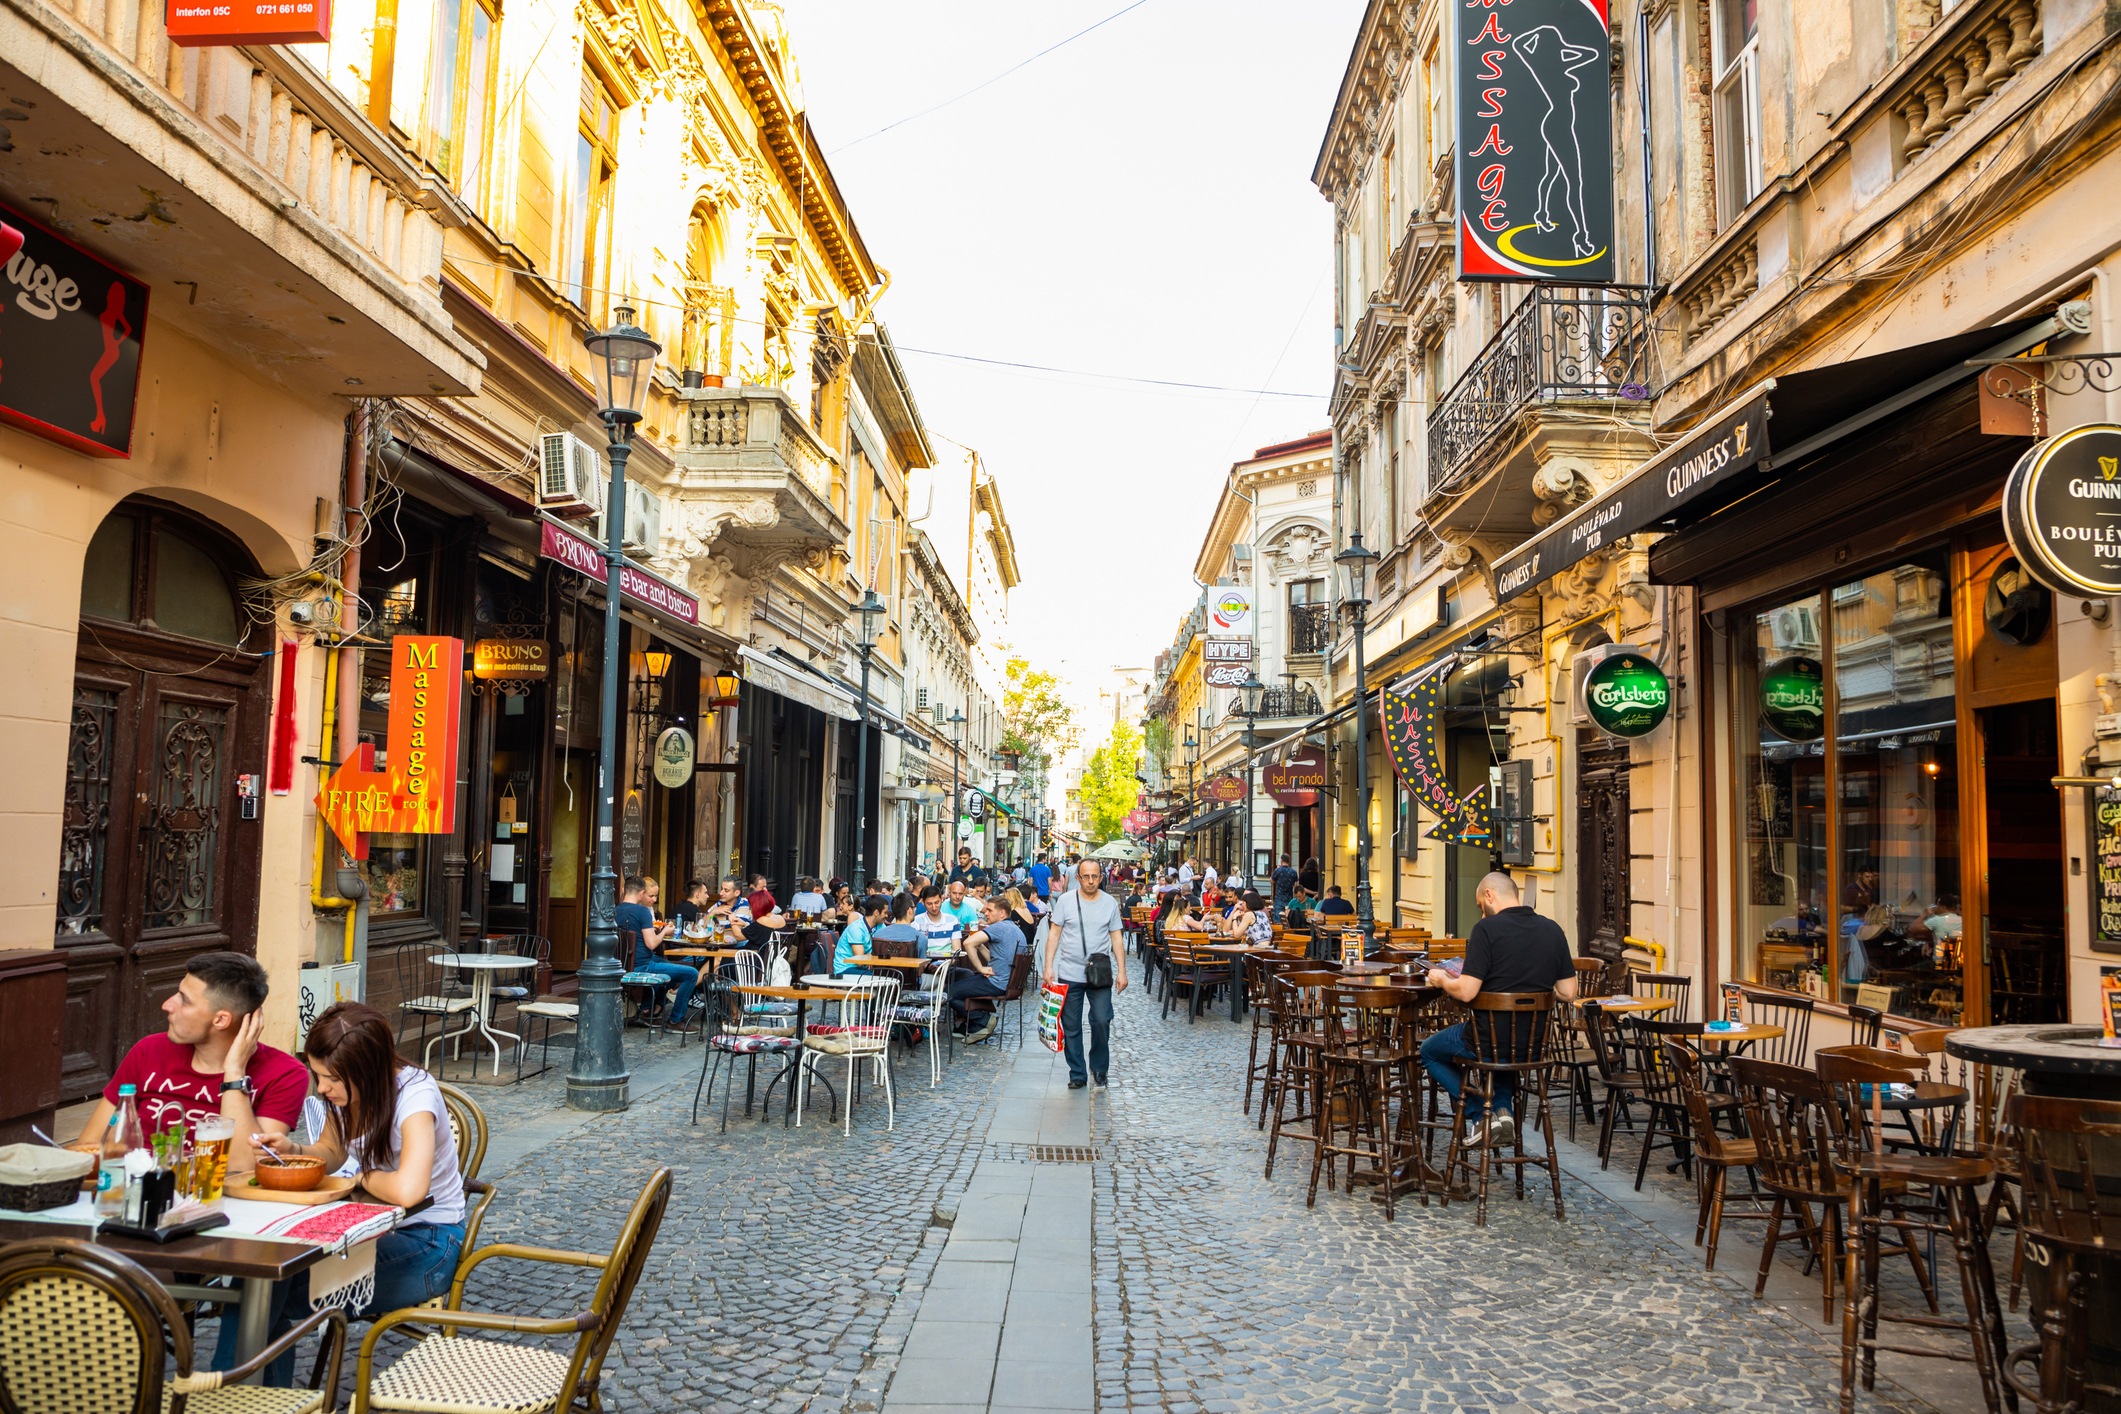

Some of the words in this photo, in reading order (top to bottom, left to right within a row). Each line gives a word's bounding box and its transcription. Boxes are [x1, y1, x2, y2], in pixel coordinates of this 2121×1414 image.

[176, 7, 211, 17] Interfon
[213, 6, 231, 16] 05C
[256, 5, 277, 15] 0721
[279, 4, 295, 14] 661
[296, 3, 313, 13] 050
[6, 249, 82, 321] uge
[1666, 438, 1730, 498] GUINNESS
[1571, 501, 1622, 543] BOULÉVARD
[1585, 530, 1601, 552] PUB
[555, 532, 598, 572] BRUNO
[630, 569, 649, 598] bar
[649, 584, 668, 610] and
[667, 588, 692, 619] bistro
[480, 643, 543, 660] BRUNO
[1208, 643, 1248, 657] HYPE
[493, 663, 507, 671] and
[529, 664, 547, 672] shop
[1593, 682, 1666, 708] Carlsberg
[1272, 773, 1287, 785] bel
[327, 790, 390, 813] FIRE
[64, 807, 73, 822] 3
[183, 813, 188, 822] 3
